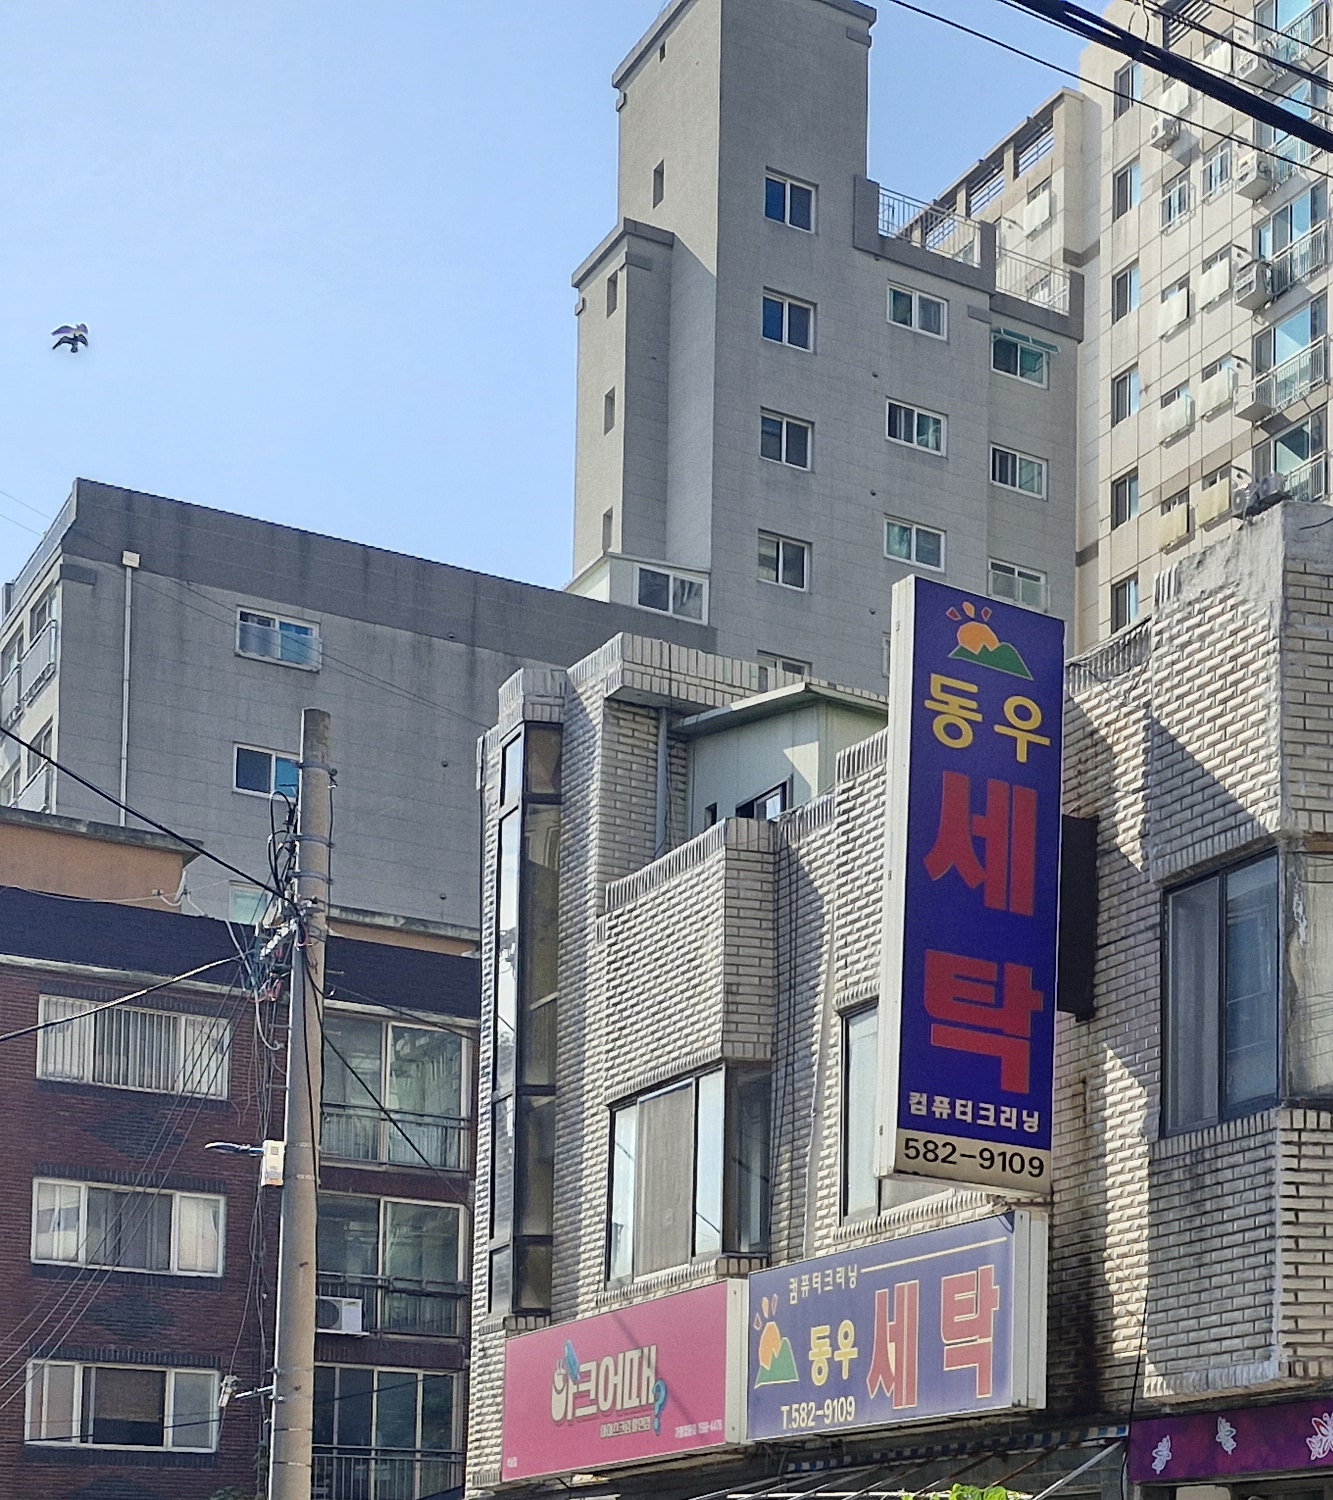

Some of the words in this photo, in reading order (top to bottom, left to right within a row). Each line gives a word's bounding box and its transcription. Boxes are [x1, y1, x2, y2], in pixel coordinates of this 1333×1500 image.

[924, 673, 1052, 763] 동우
[923, 769, 1044, 1094] 세탁
[908, 1091, 1040, 1134] 컴퓨터크리닝
[904, 1138, 1046, 1179] 582-9109
[789, 1264, 859, 1305] 컴퓨터크리닝
[808, 1319, 858, 1387] 동우
[867, 1265, 1000, 1410] 세탁
[781, 1394, 856, 1431] T.582-9109
